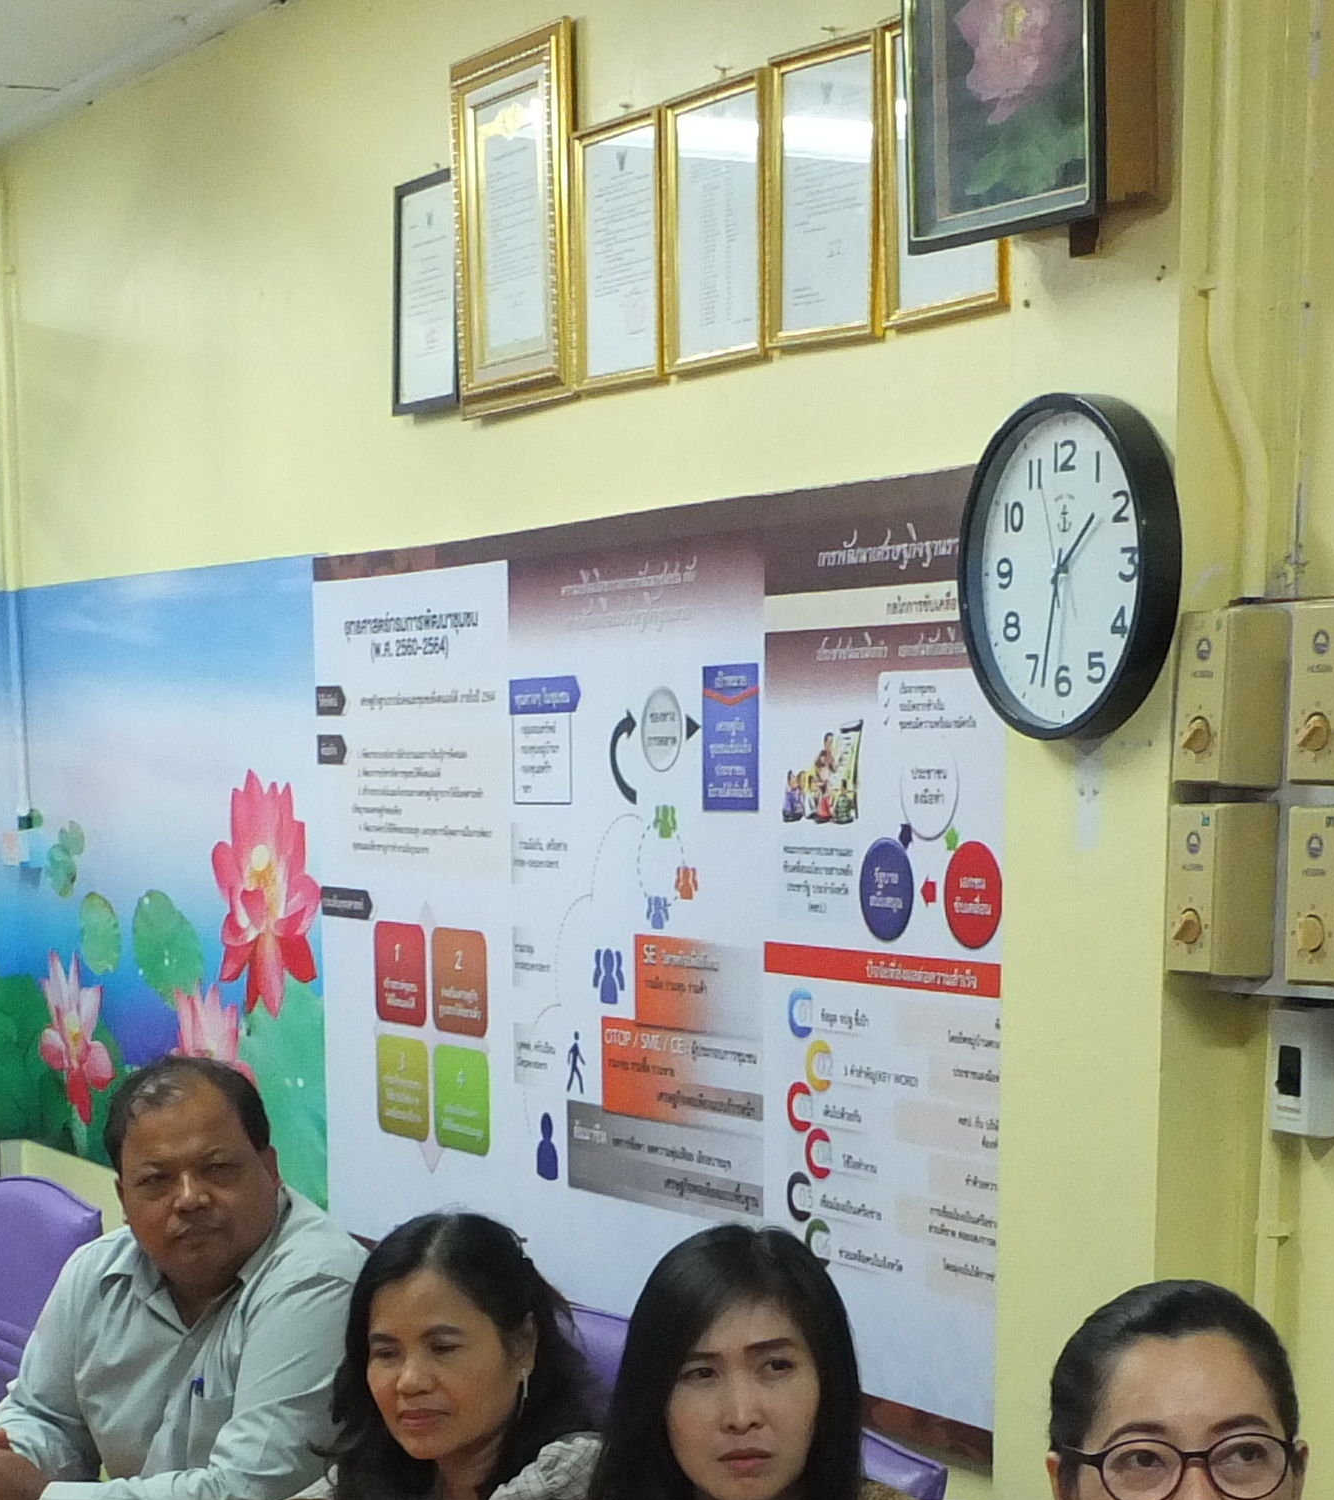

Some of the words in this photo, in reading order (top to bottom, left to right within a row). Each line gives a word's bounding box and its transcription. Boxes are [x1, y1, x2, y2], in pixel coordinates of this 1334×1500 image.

[1053, 439, 1078, 473] 12
[1028, 458, 1042, 490] 11
[1004, 501, 1024, 533] 10
[1111, 490, 1130, 523] 2
[817, 523, 959, 571] การพัฒนาเศรษฐกิจฐานรา
[997, 557, 1013, 589] 9
[1118, 546, 1139, 582] 3
[886, 590, 958, 616] กลไกการขับเคลื่อ
[1003, 611, 1021, 642] 8
[1110, 605, 1128, 639] 4
[1025, 654, 1039, 685] 7
[1054, 665, 1072, 698] 6
[1086, 651, 1106, 684] 5
[394, 943, 402, 963] 1
[454, 950, 464, 970] 2
[643, 944, 657, 965] SE
